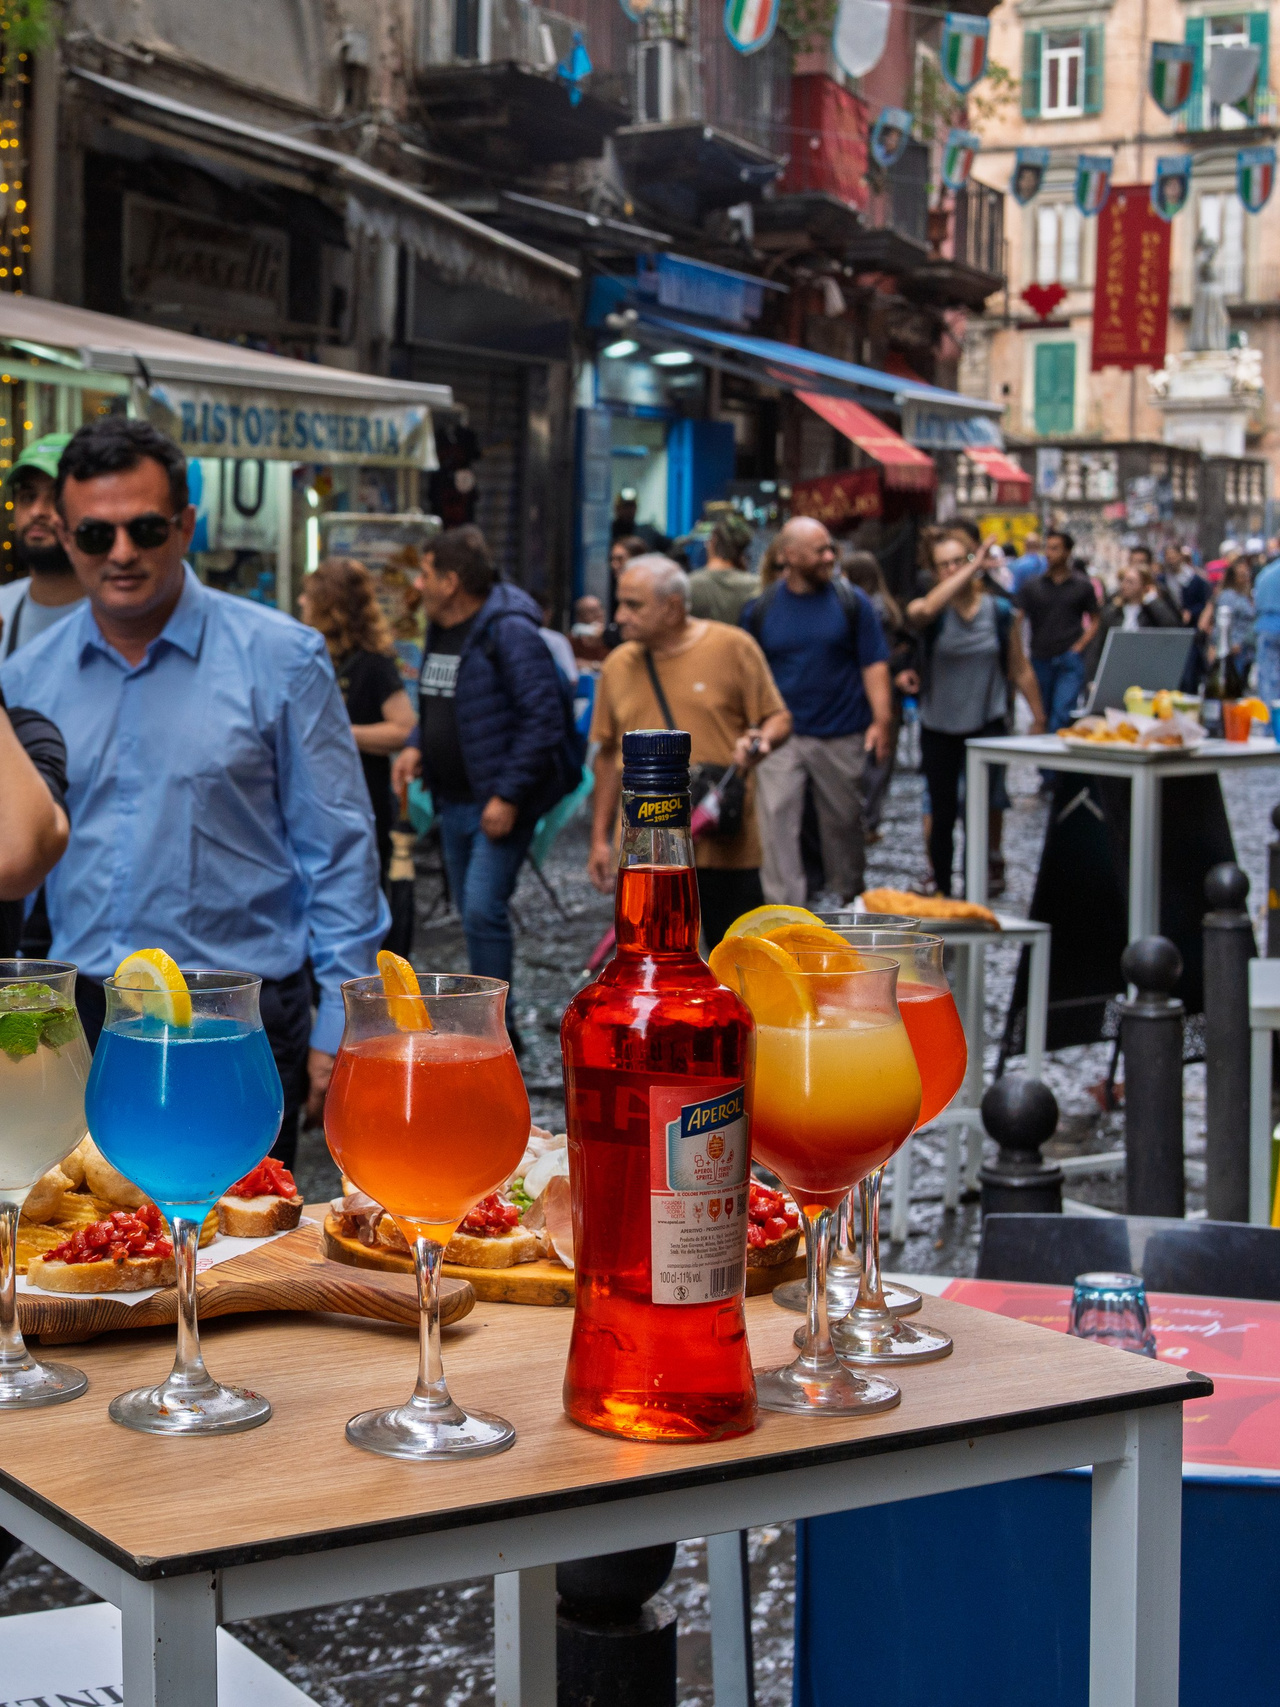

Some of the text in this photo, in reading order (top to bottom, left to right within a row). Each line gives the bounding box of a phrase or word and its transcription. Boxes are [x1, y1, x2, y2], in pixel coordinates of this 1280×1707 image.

[180, 402, 400, 456] RISTOPESCHERIA
[638, 798, 682, 818] APEROL
[654, 814, 669, 822] 1919
[687, 1096, 740, 1132] APEROL
